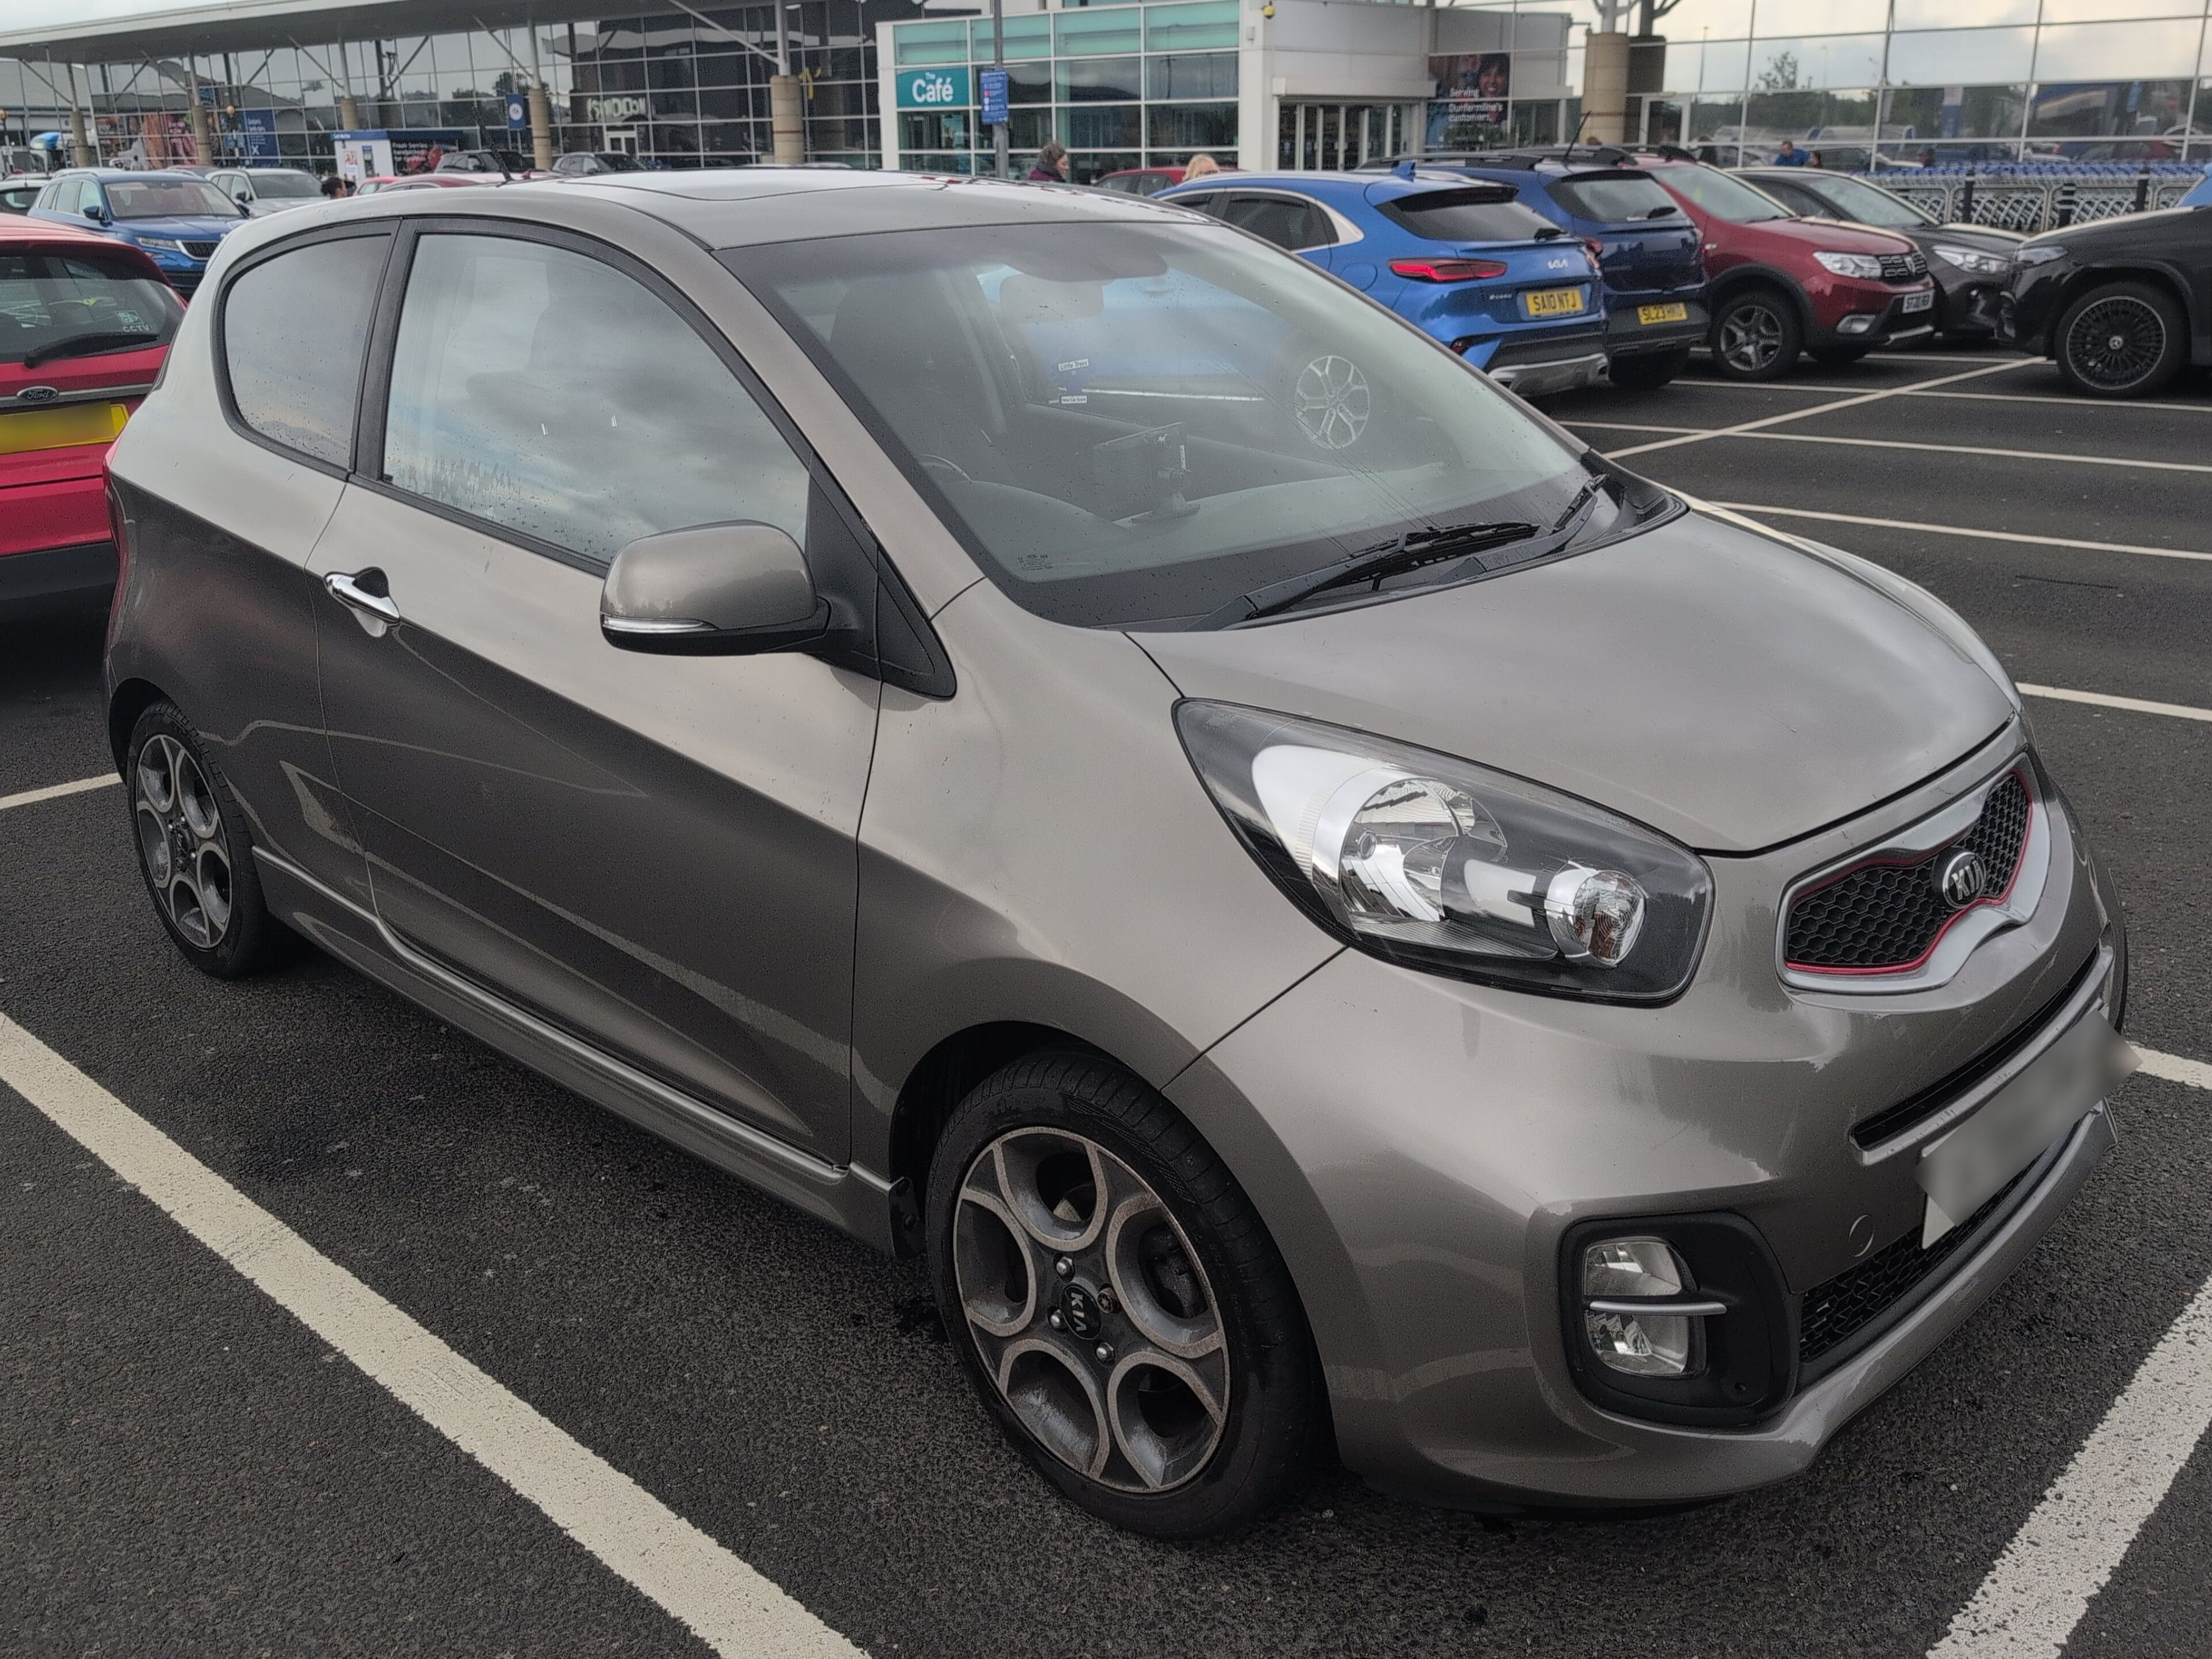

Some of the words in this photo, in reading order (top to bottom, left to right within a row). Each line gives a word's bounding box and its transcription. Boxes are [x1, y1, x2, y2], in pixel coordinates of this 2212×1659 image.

[912, 77, 953, 102] Café
[1450, 88, 1480, 98] Serving
[1448, 102, 1504, 112] Dunfermline's
[27, 389, 50, 400] Ford
[1951, 860, 1985, 901] KIA
[1071, 1292, 1087, 1332] KIA
